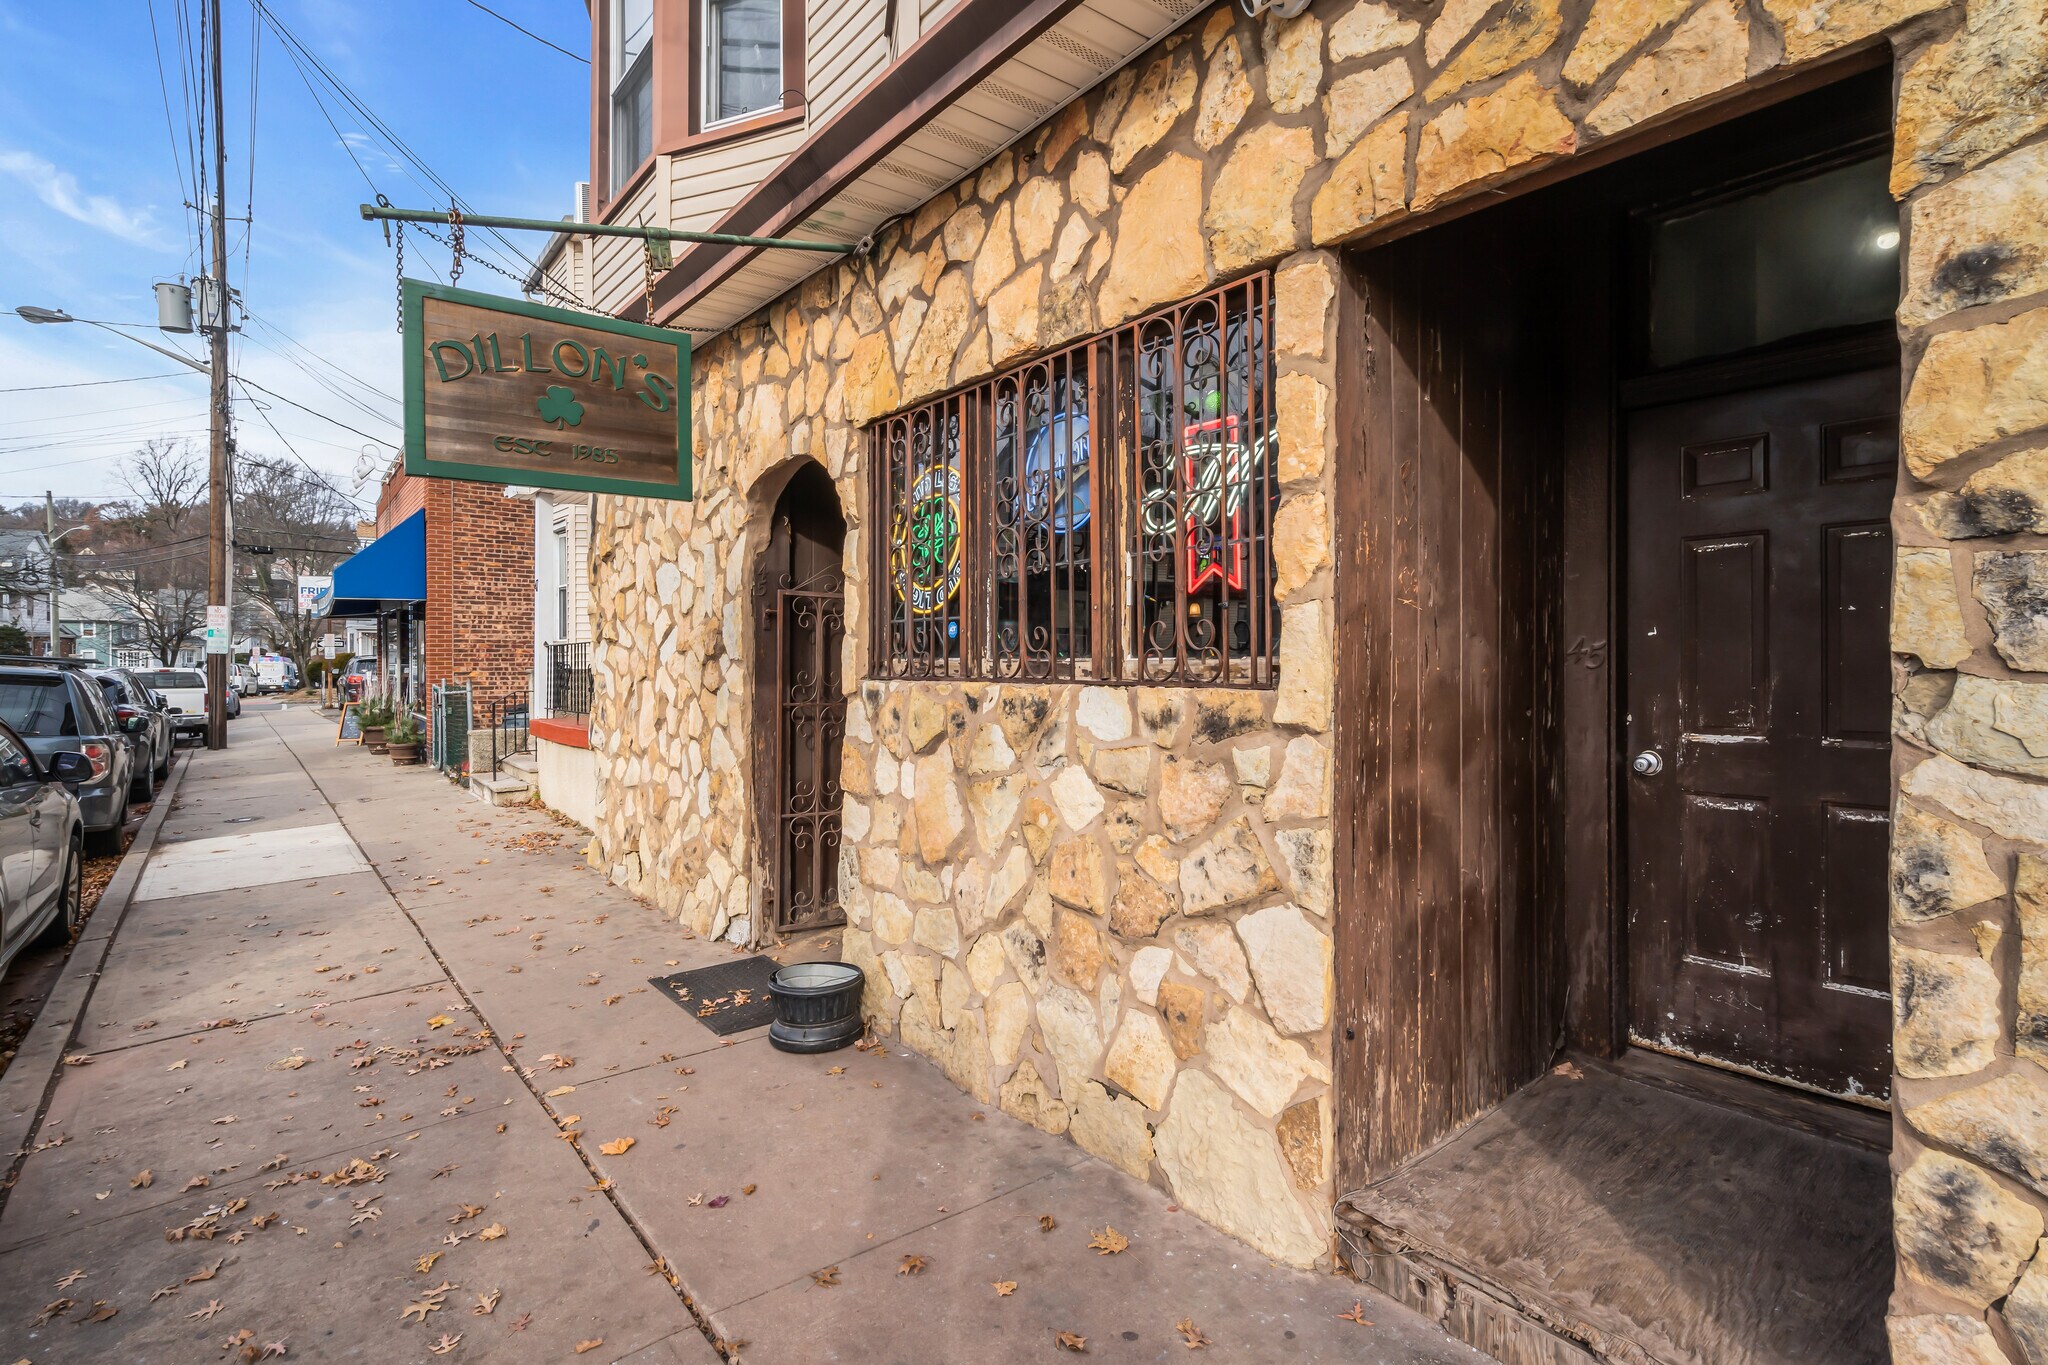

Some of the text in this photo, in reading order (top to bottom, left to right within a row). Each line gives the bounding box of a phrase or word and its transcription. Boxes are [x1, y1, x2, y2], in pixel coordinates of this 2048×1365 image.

[429, 332, 674, 412] DILLON'S
[493, 436, 619, 464] EST 1985
